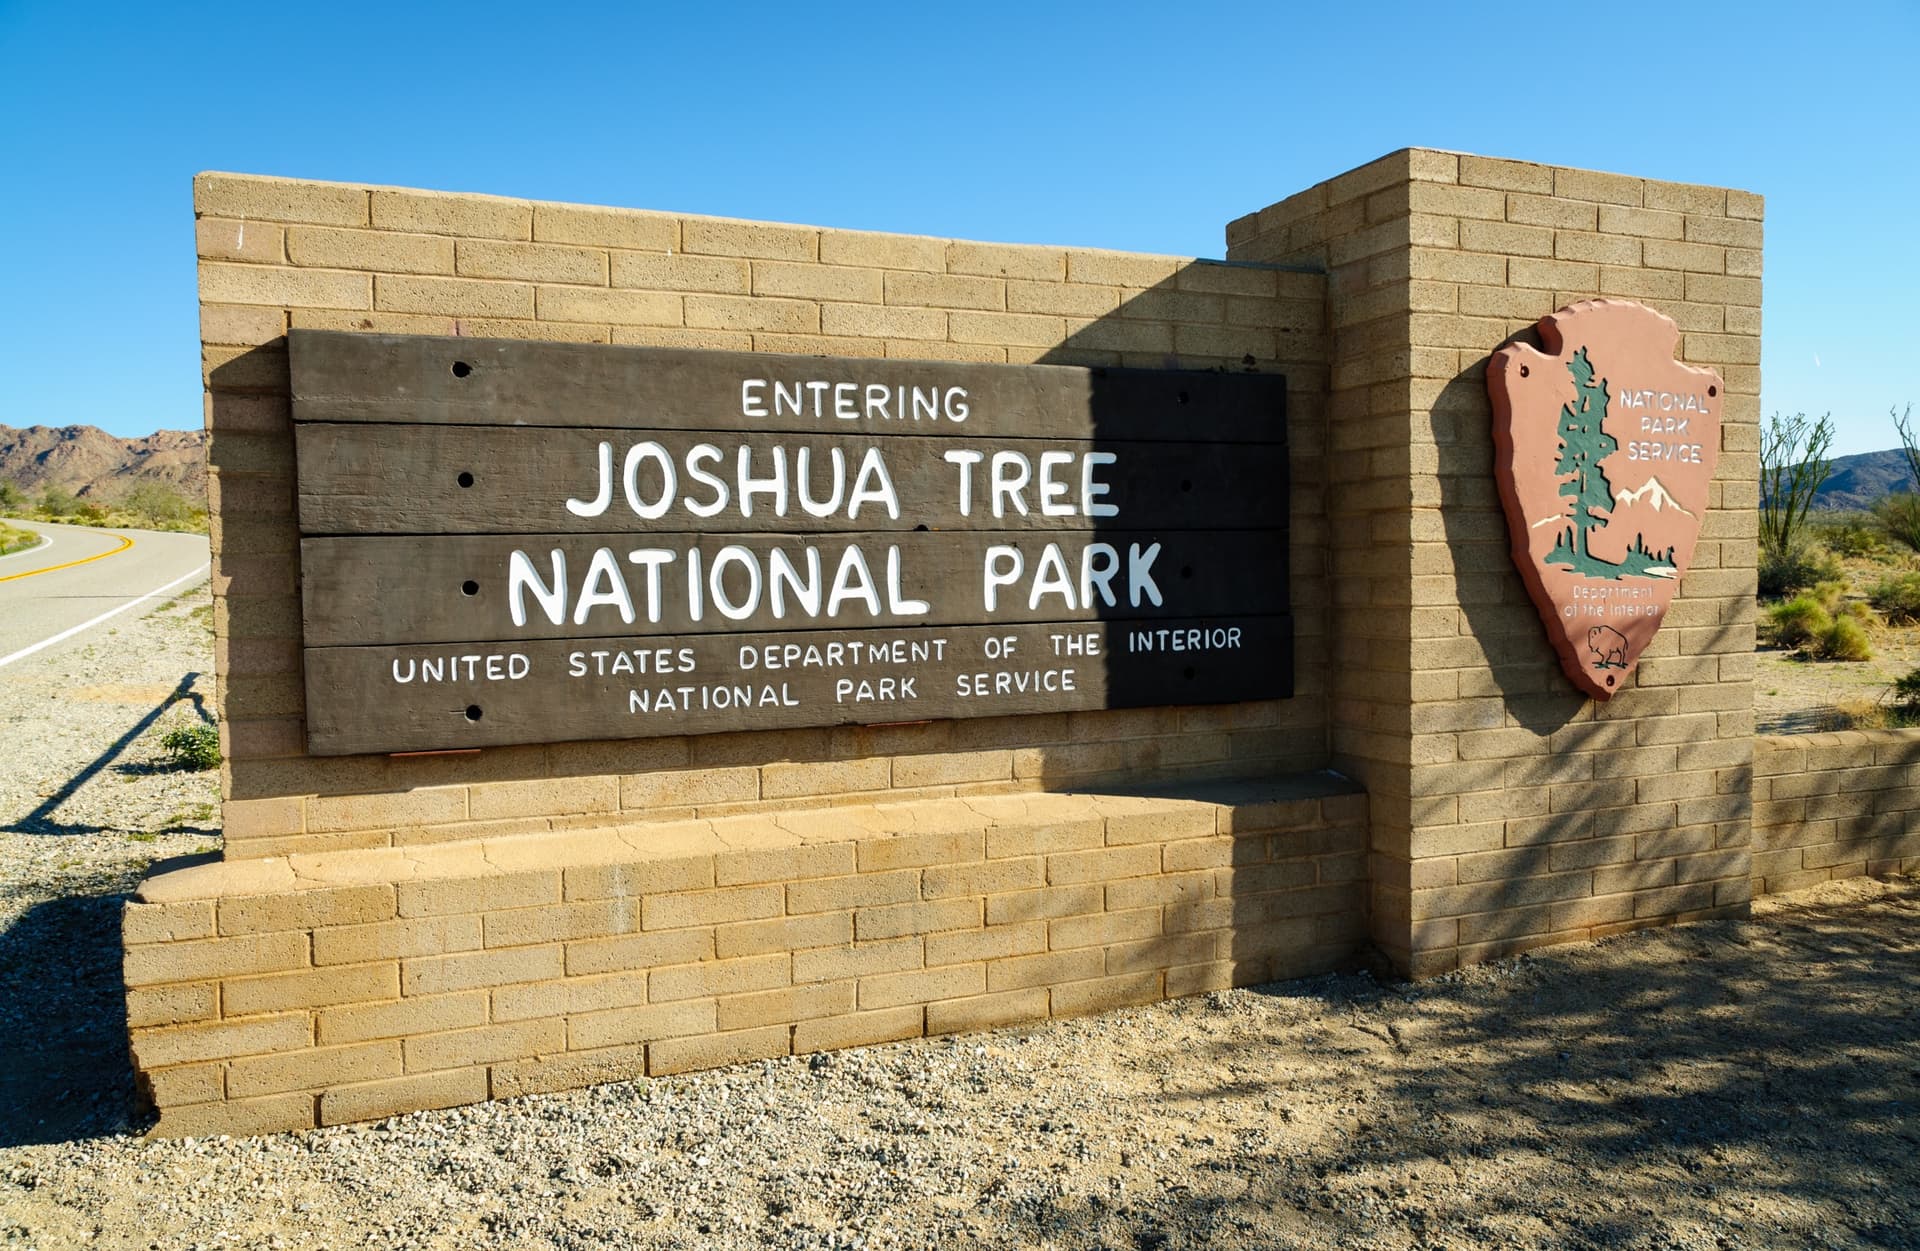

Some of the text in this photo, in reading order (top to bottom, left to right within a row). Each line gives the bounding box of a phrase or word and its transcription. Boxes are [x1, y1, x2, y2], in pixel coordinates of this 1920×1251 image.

[742, 379, 970, 423] ENTERING
[1620, 388, 1711, 414] NATIONAL
[1641, 416, 1690, 436] PARK
[1628, 441, 1703, 464] SERVICE
[565, 441, 1121, 520] JOSHUA TREE
[508, 542, 1163, 627] NATIONAL PARK
[1573, 584, 1653, 600] Department
[1564, 603, 1660, 617] of the Interior
[392, 627, 1241, 684] UNITED STATES DEPARTMENT OF THE INTERIOR
[629, 669, 1076, 714] NATIONAL PARK SERVICE
